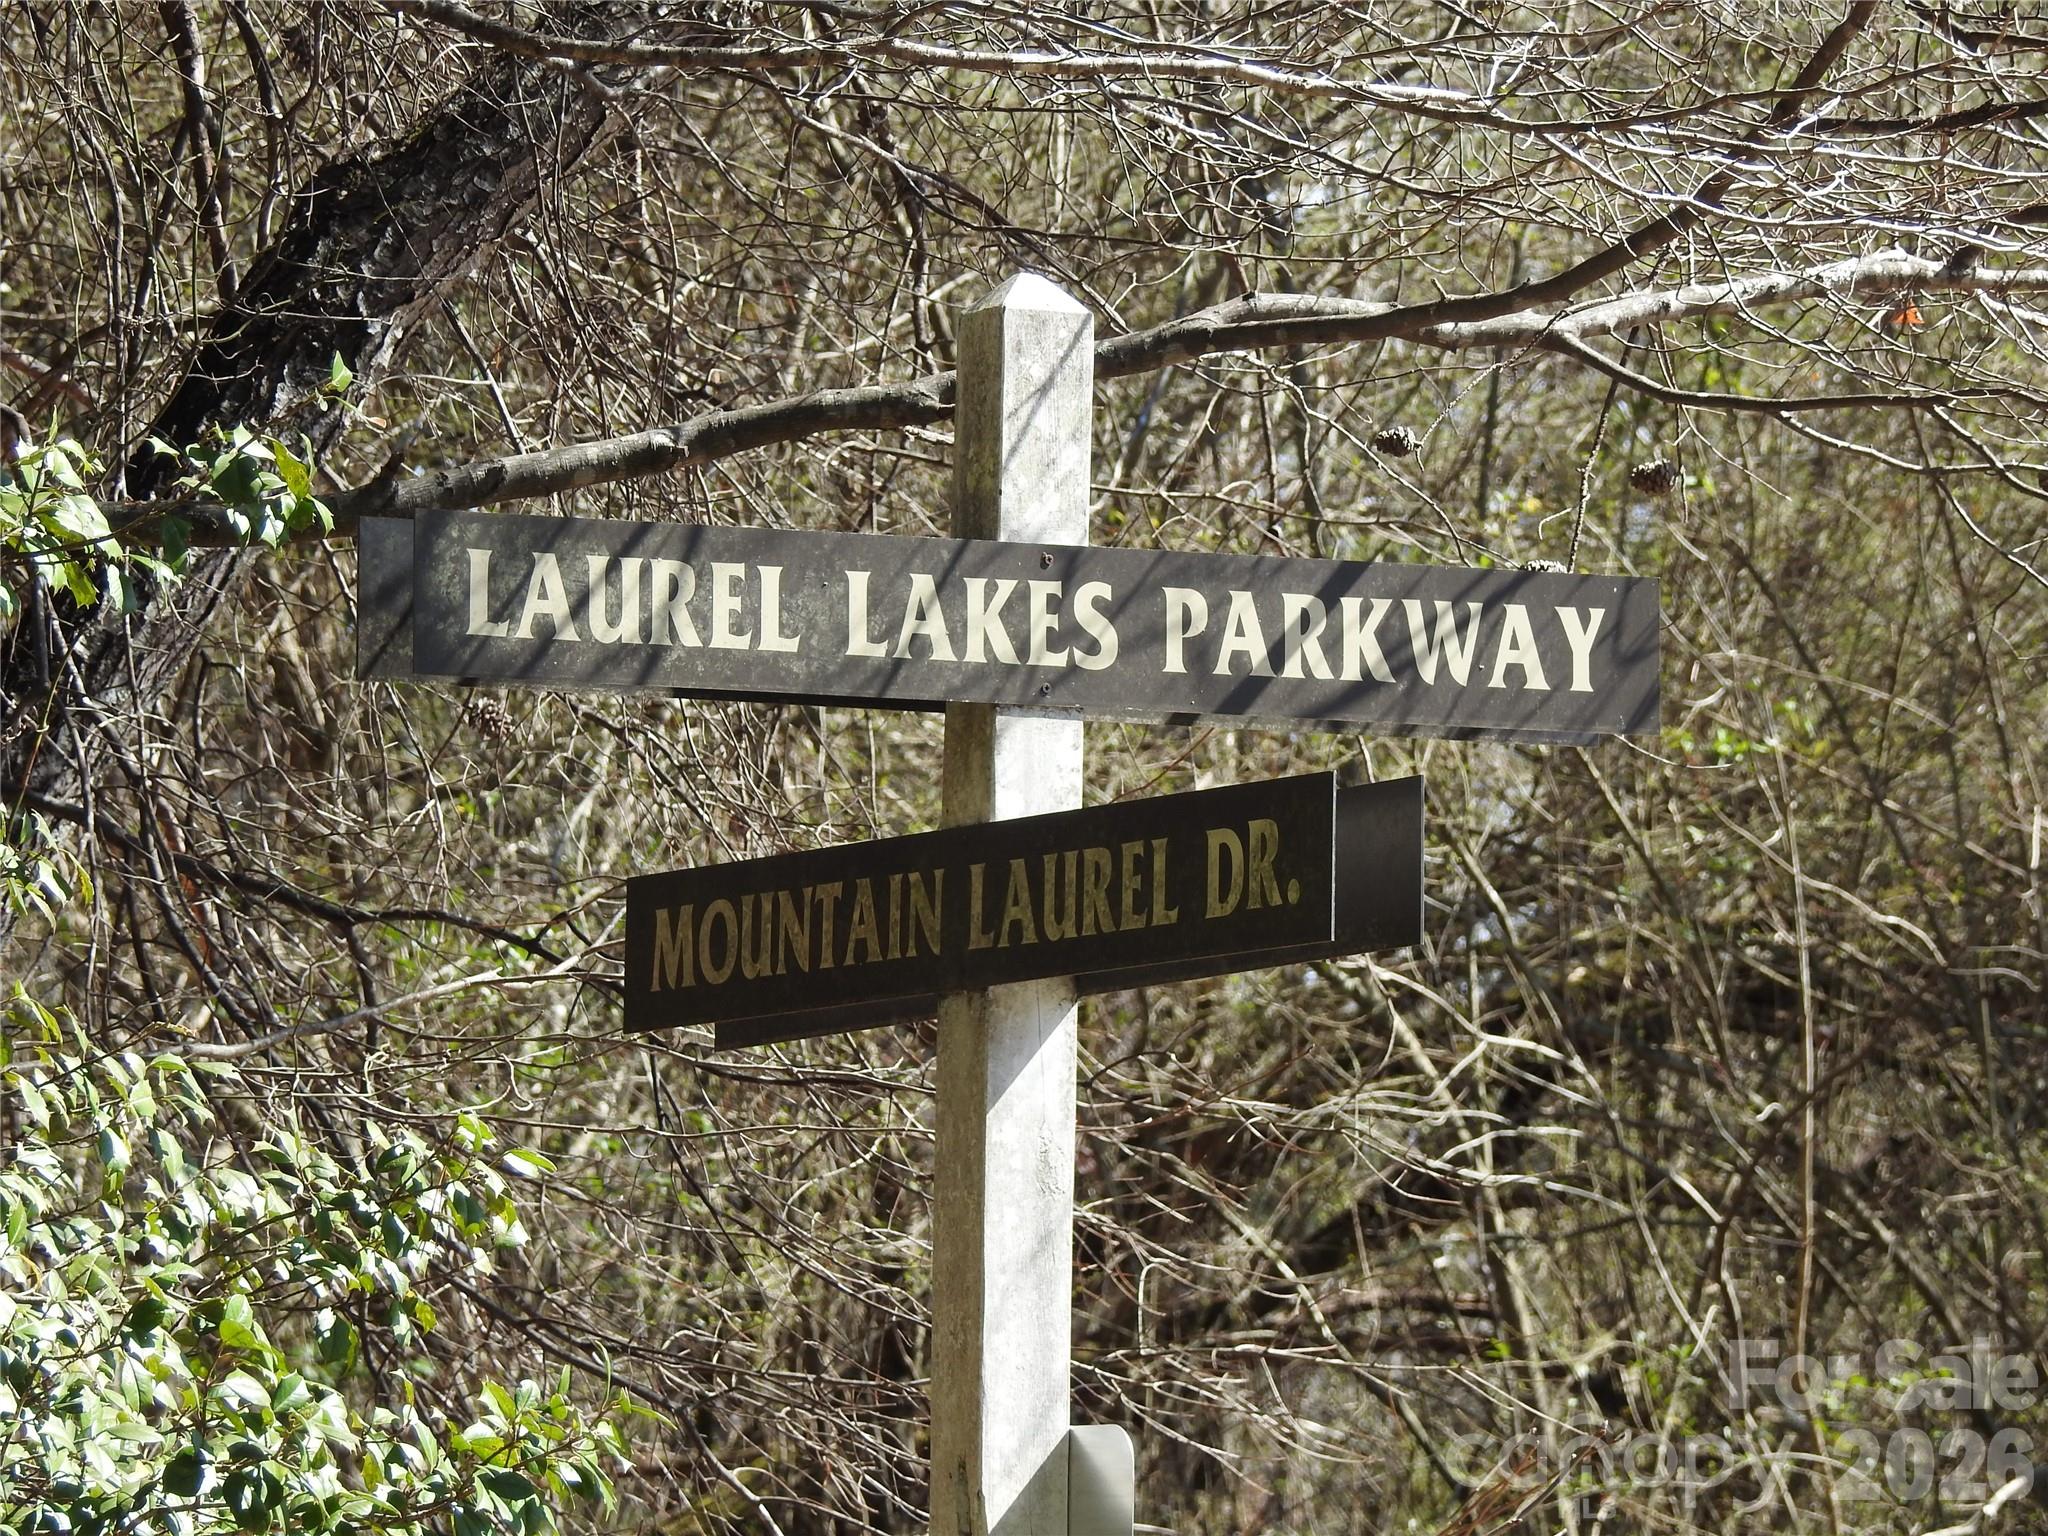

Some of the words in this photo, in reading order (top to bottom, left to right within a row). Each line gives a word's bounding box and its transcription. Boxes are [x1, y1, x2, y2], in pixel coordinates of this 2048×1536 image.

[466, 547, 801, 653] LAUREL
[845, 569, 1119, 671] LAKES
[1162, 586, 1606, 692] PARKWAY
[650, 867, 944, 993] MOUNTAIN
[966, 836, 1179, 951] LAUREL
[1204, 817, 1302, 920] DR.
